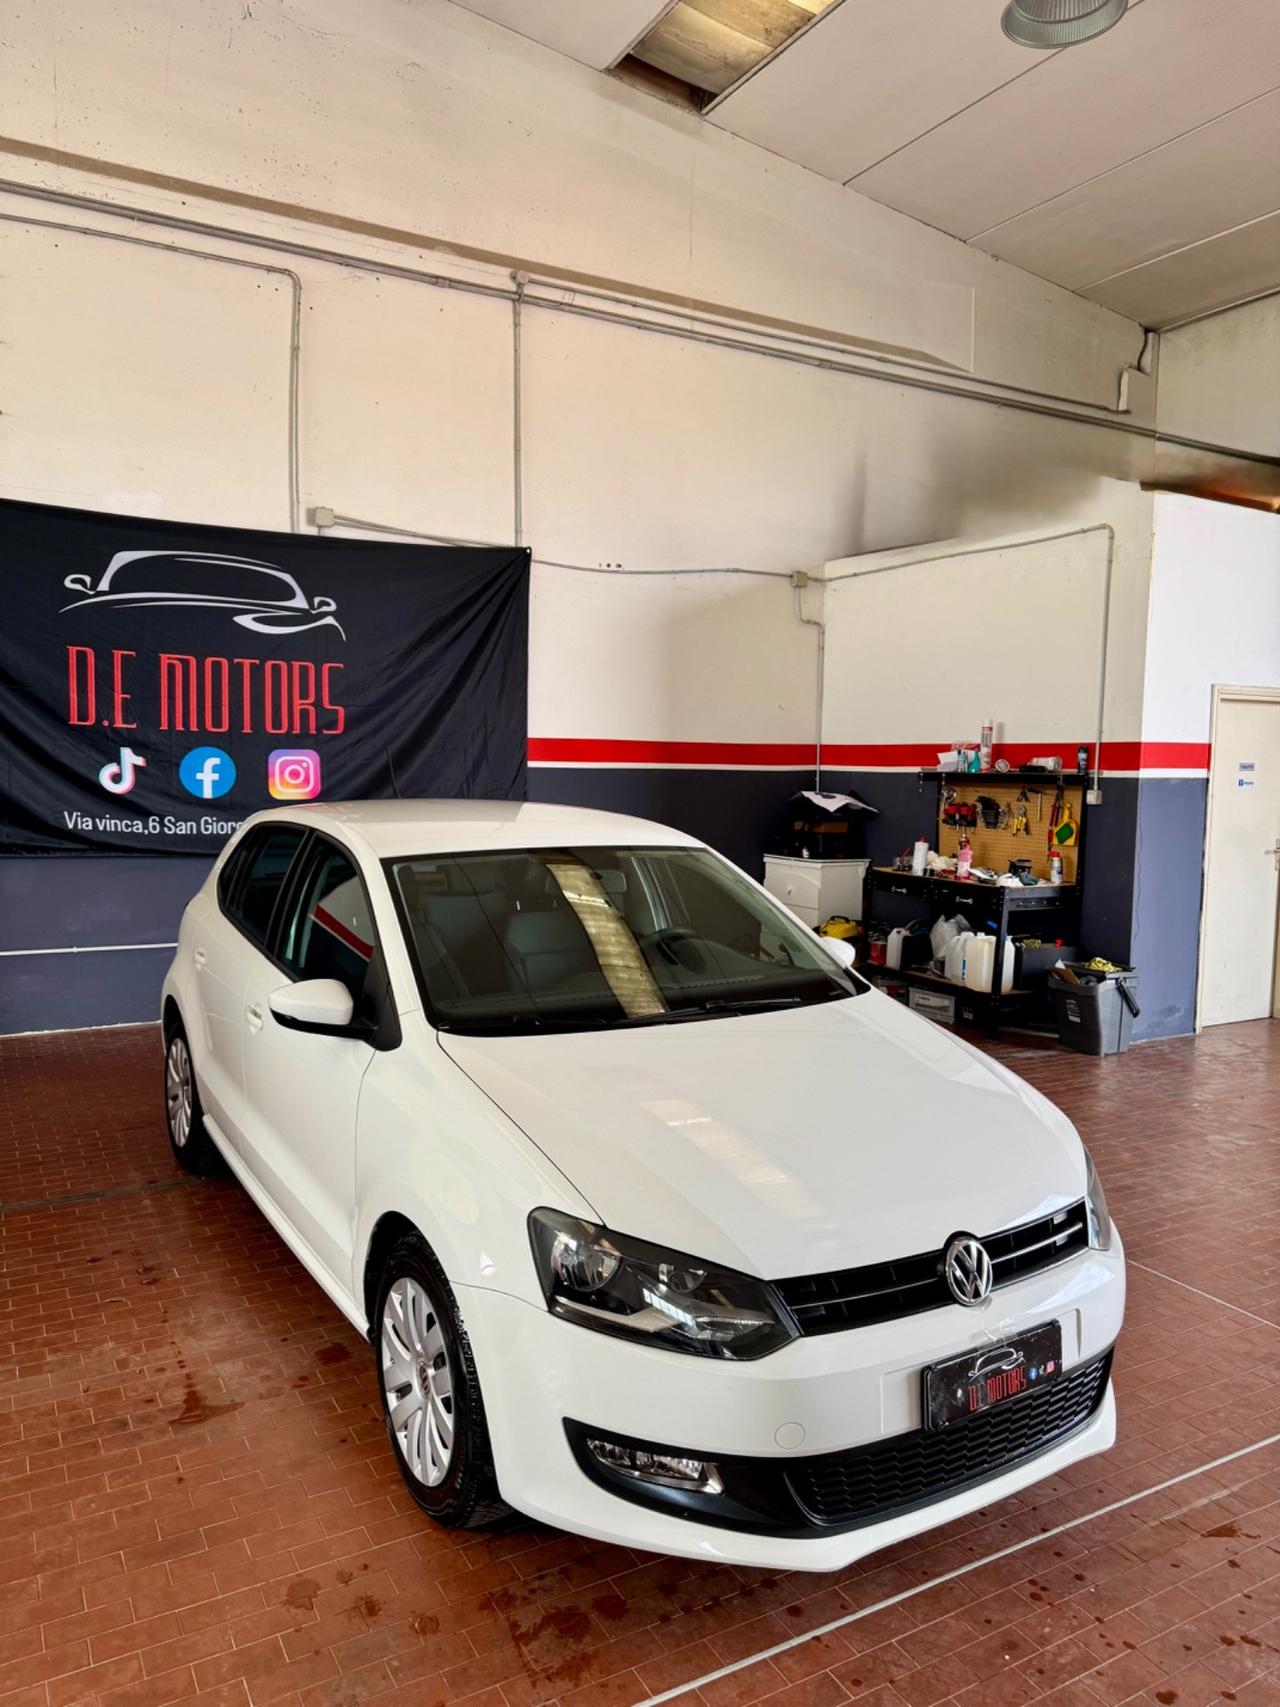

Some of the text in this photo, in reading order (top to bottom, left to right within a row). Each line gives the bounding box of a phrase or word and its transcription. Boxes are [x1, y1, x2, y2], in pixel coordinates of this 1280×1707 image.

[66, 645, 346, 734] D.E MOTORS
[63, 811, 93, 830] Via
[163, 816, 197, 834] San
[987, 1366, 1028, 1405] MOTORS
